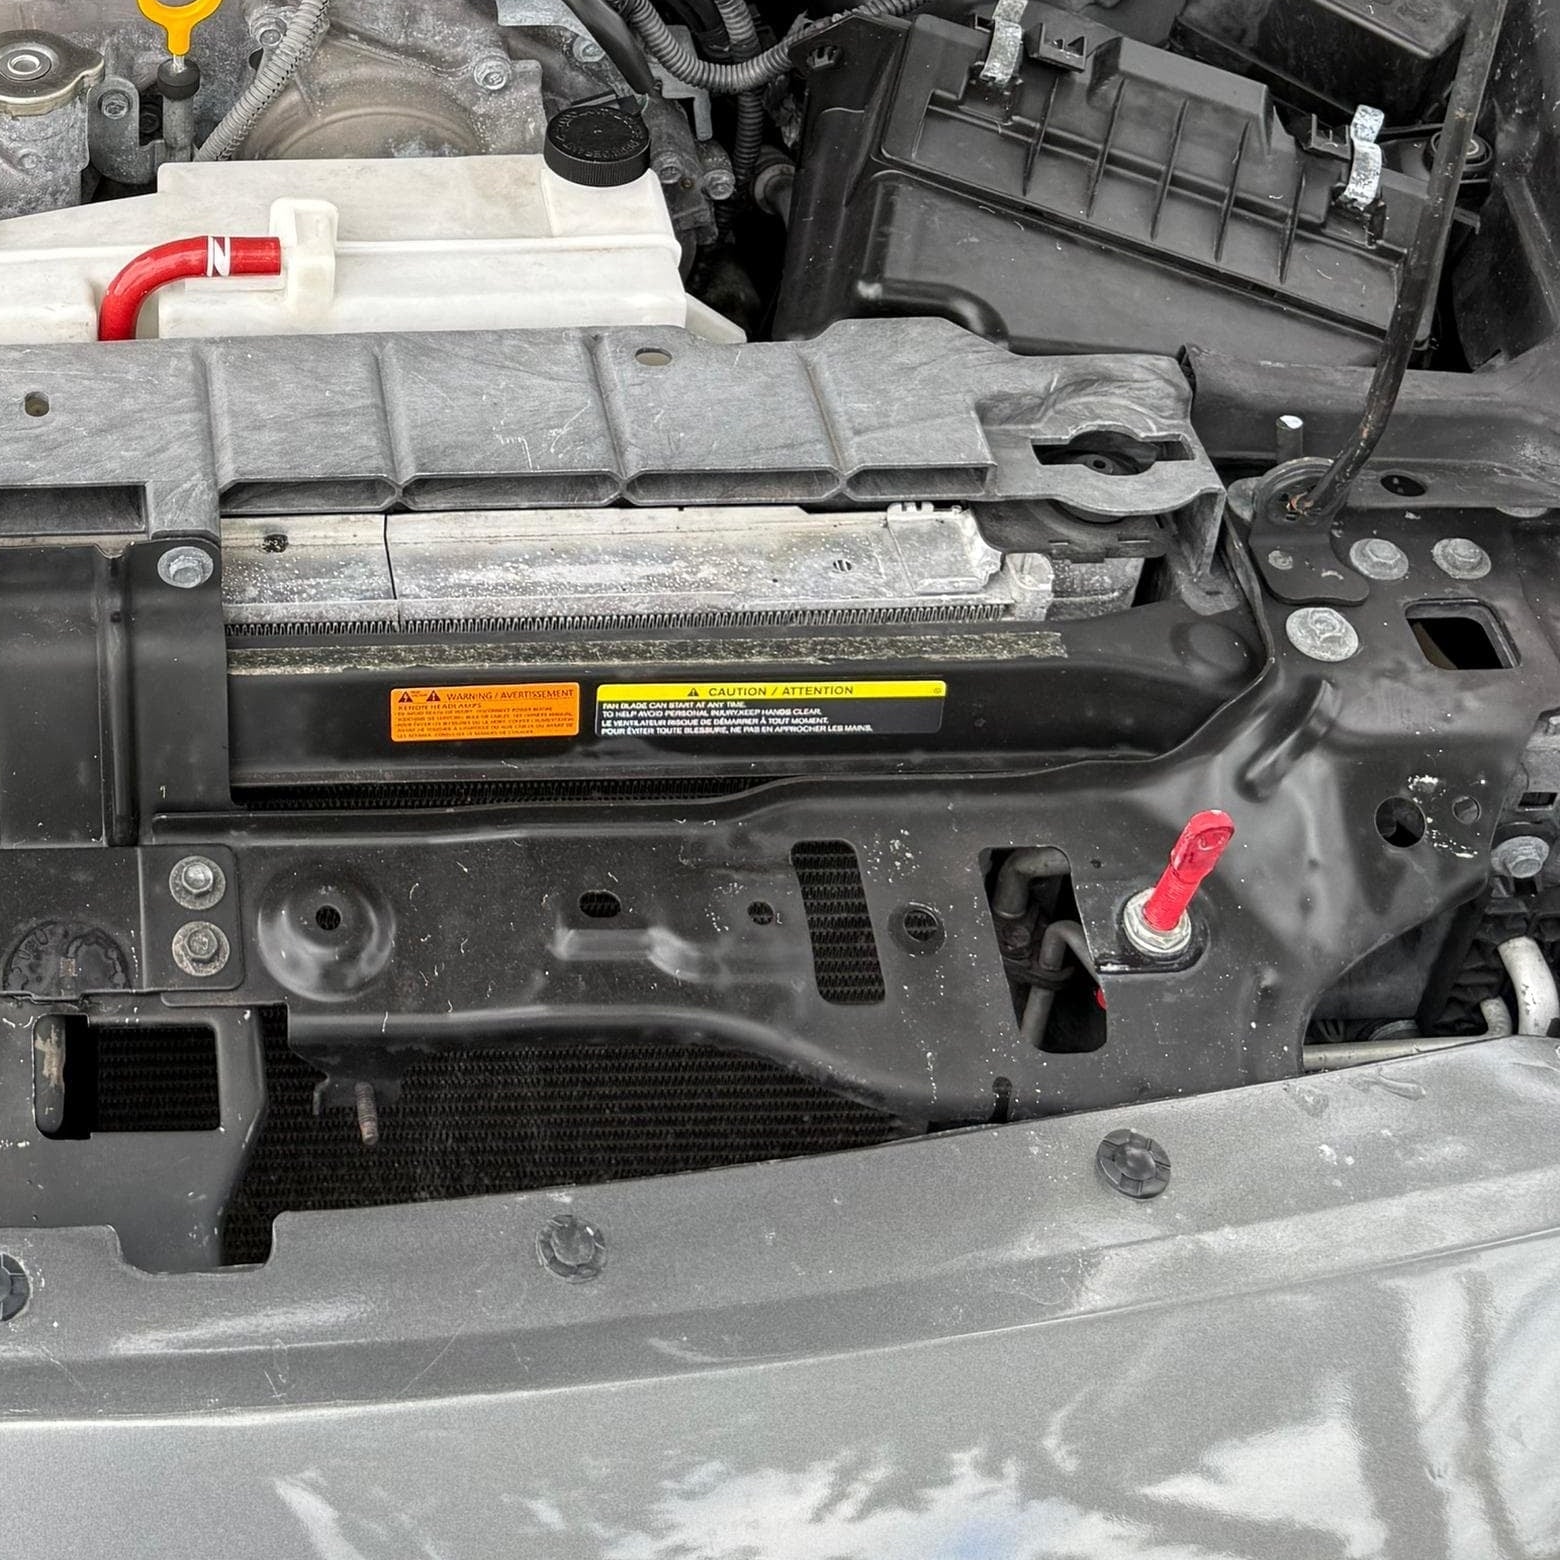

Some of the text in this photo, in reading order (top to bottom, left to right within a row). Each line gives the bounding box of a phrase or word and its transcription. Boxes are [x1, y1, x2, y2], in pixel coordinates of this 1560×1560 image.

[447, 692, 492, 701] WARNING
[500, 689, 573, 699] AVERTISSEMENT
[708, 686, 854, 697] CAUTION / ATTENTION
[664, 710, 708, 718] PERSONAL
[601, 719, 612, 727] LE
[613, 719, 667, 727] VENTILATEUR
[767, 717, 790, 725] TOUT
[601, 727, 625, 736] POUR
[656, 727, 683, 735] TOUTE
[730, 726, 742, 734] NE
[743, 726, 760, 734] PAS
[774, 725, 827, 733] APPROCHER
